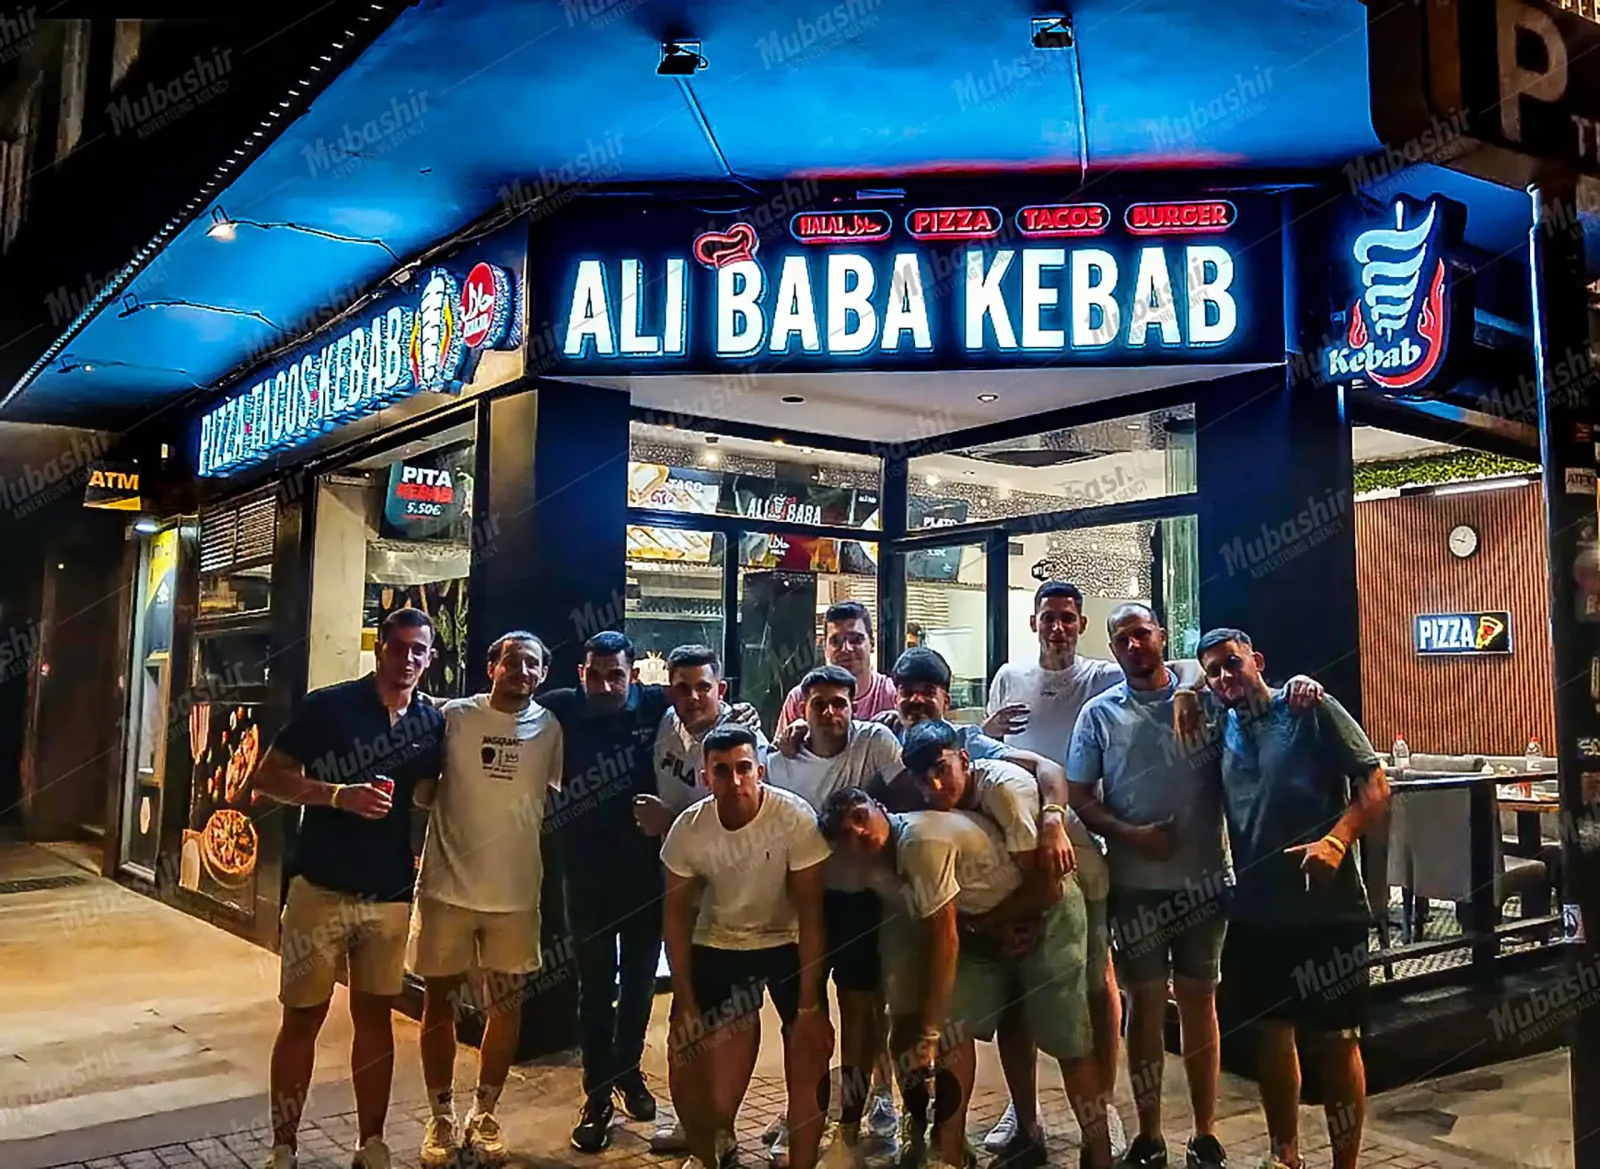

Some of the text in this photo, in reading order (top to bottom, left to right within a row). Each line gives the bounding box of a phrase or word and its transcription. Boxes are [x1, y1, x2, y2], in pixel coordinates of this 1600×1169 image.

[800, 216, 844, 235] HALAL
[914, 210, 992, 232] PIZZA
[1024, 207, 1102, 230] TACOS
[1132, 204, 1228, 227] BURGER
[563, 246, 1238, 359] ALI BABA KEBAB
[1328, 337, 1422, 376] Kebab
[198, 306, 402, 477] PIZZA TACOS KEBAB
[88, 470, 139, 491] ATM
[401, 466, 453, 488] PITA
[406, 502, 442, 516] 5.50€
[787, 503, 821, 524] BABA
[1419, 617, 1476, 650] PIZZA
[661, 751, 696, 788] FILA
